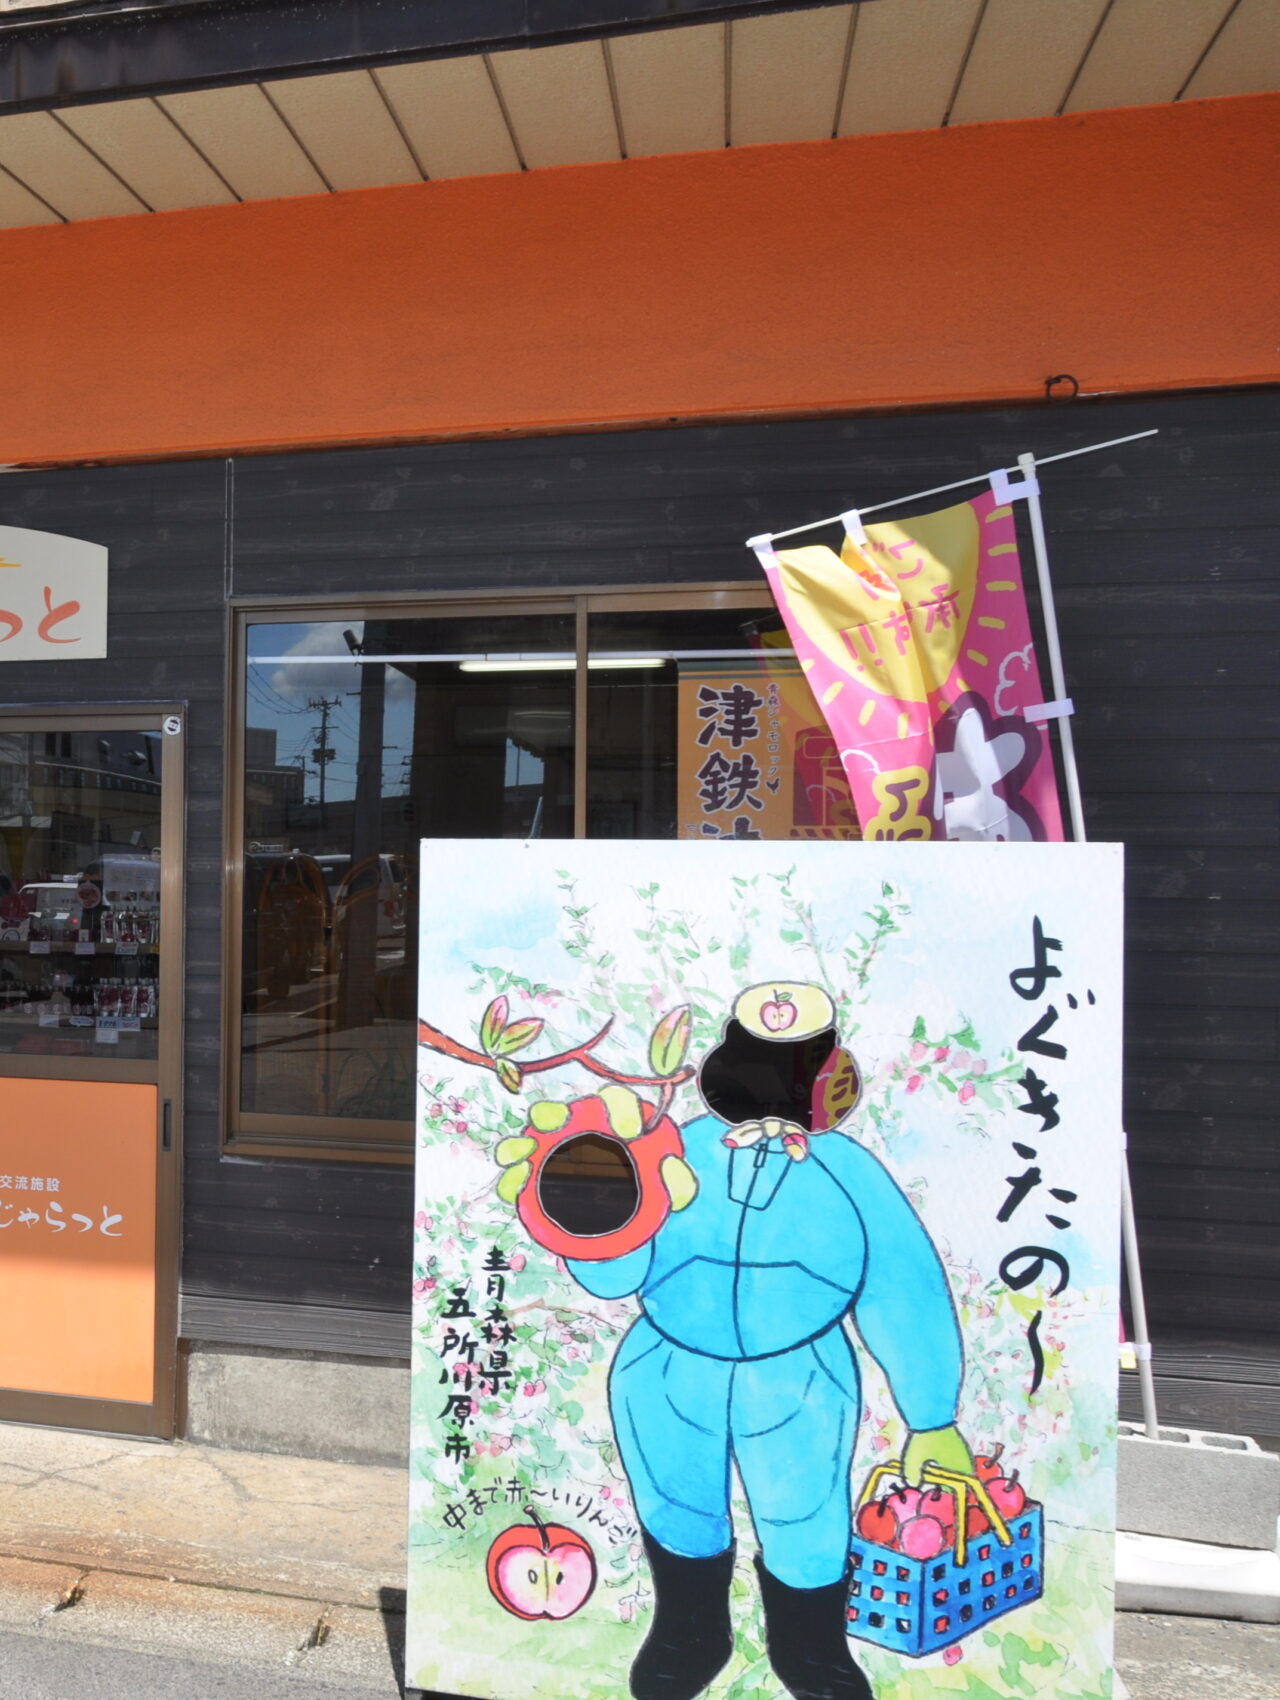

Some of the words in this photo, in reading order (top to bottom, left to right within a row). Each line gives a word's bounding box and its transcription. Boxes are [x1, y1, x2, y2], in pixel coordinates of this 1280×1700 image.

[767, 683, 781, 777] 青森シャモロック
[436, 1287, 480, 1465] 五所川原市
[478, 1245, 517, 1395] 青森県
